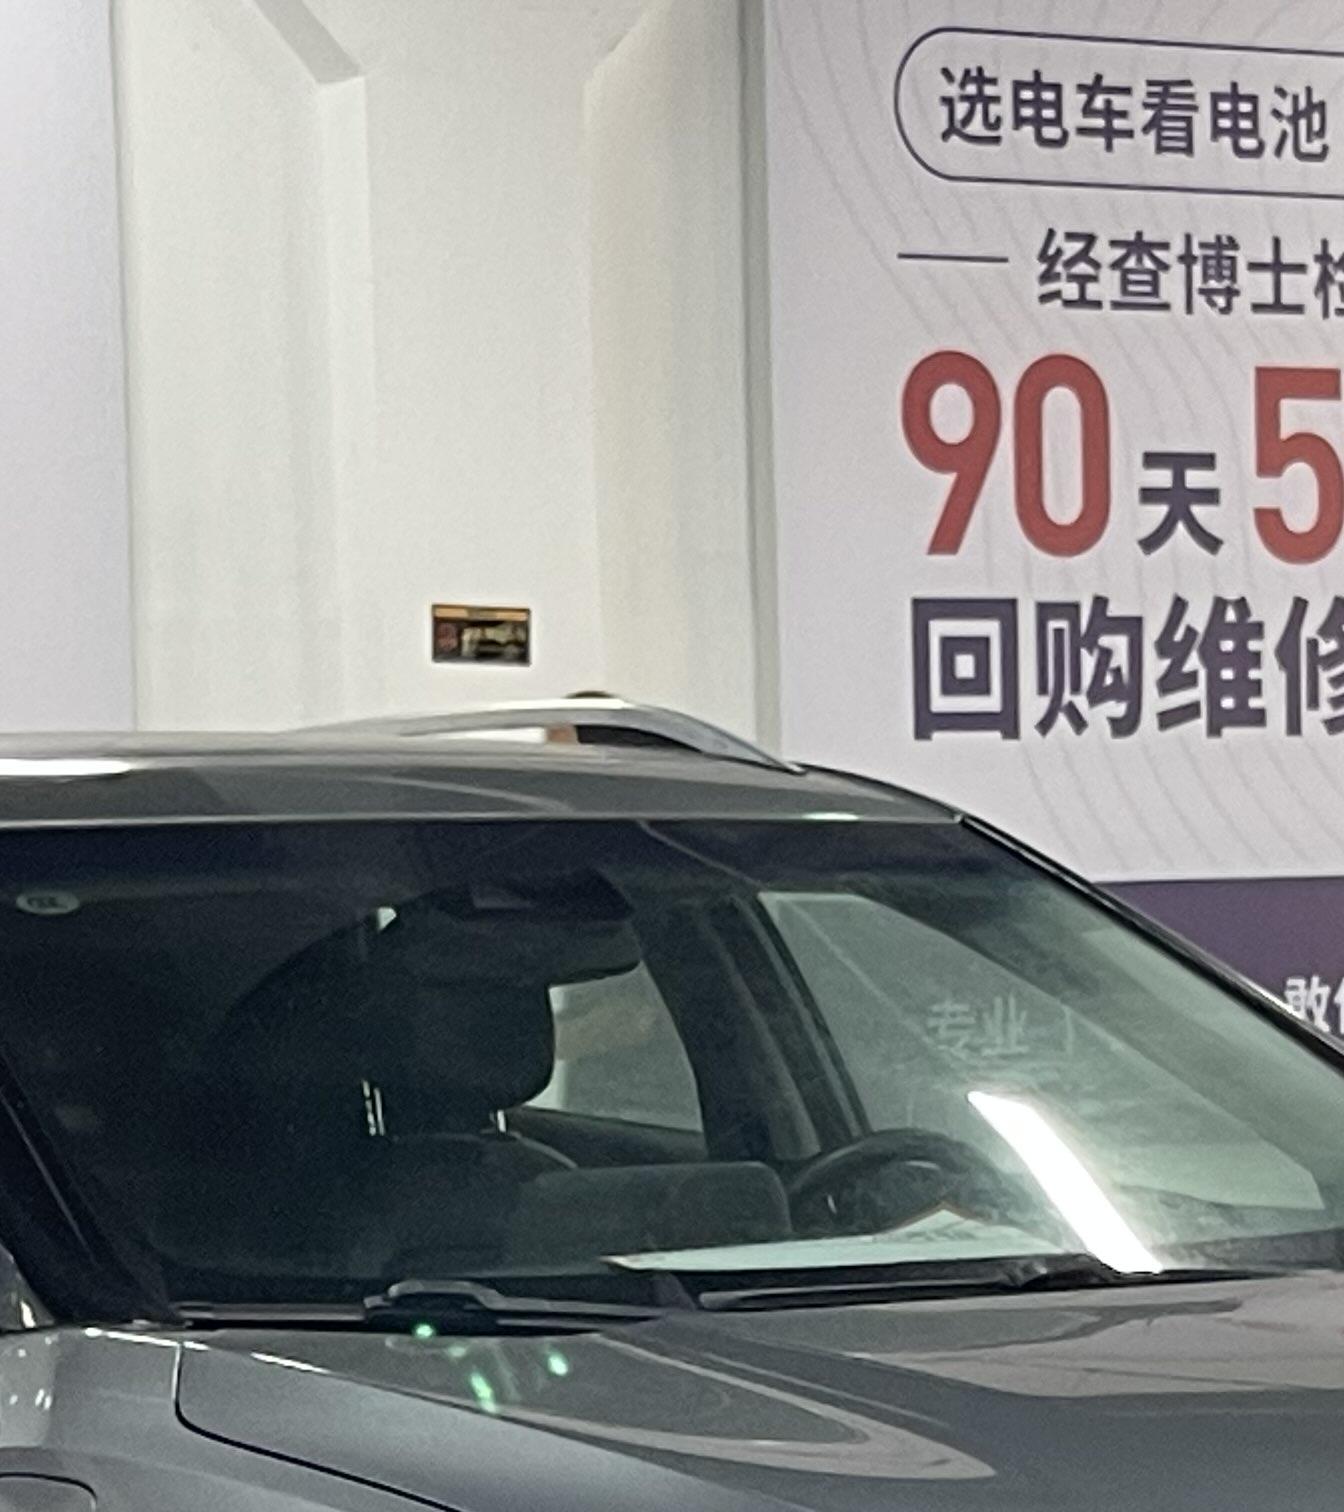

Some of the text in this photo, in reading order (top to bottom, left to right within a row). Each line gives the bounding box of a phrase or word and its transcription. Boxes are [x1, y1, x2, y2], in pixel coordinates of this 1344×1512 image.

[939, 65, 1331, 163] 选电车看电池
